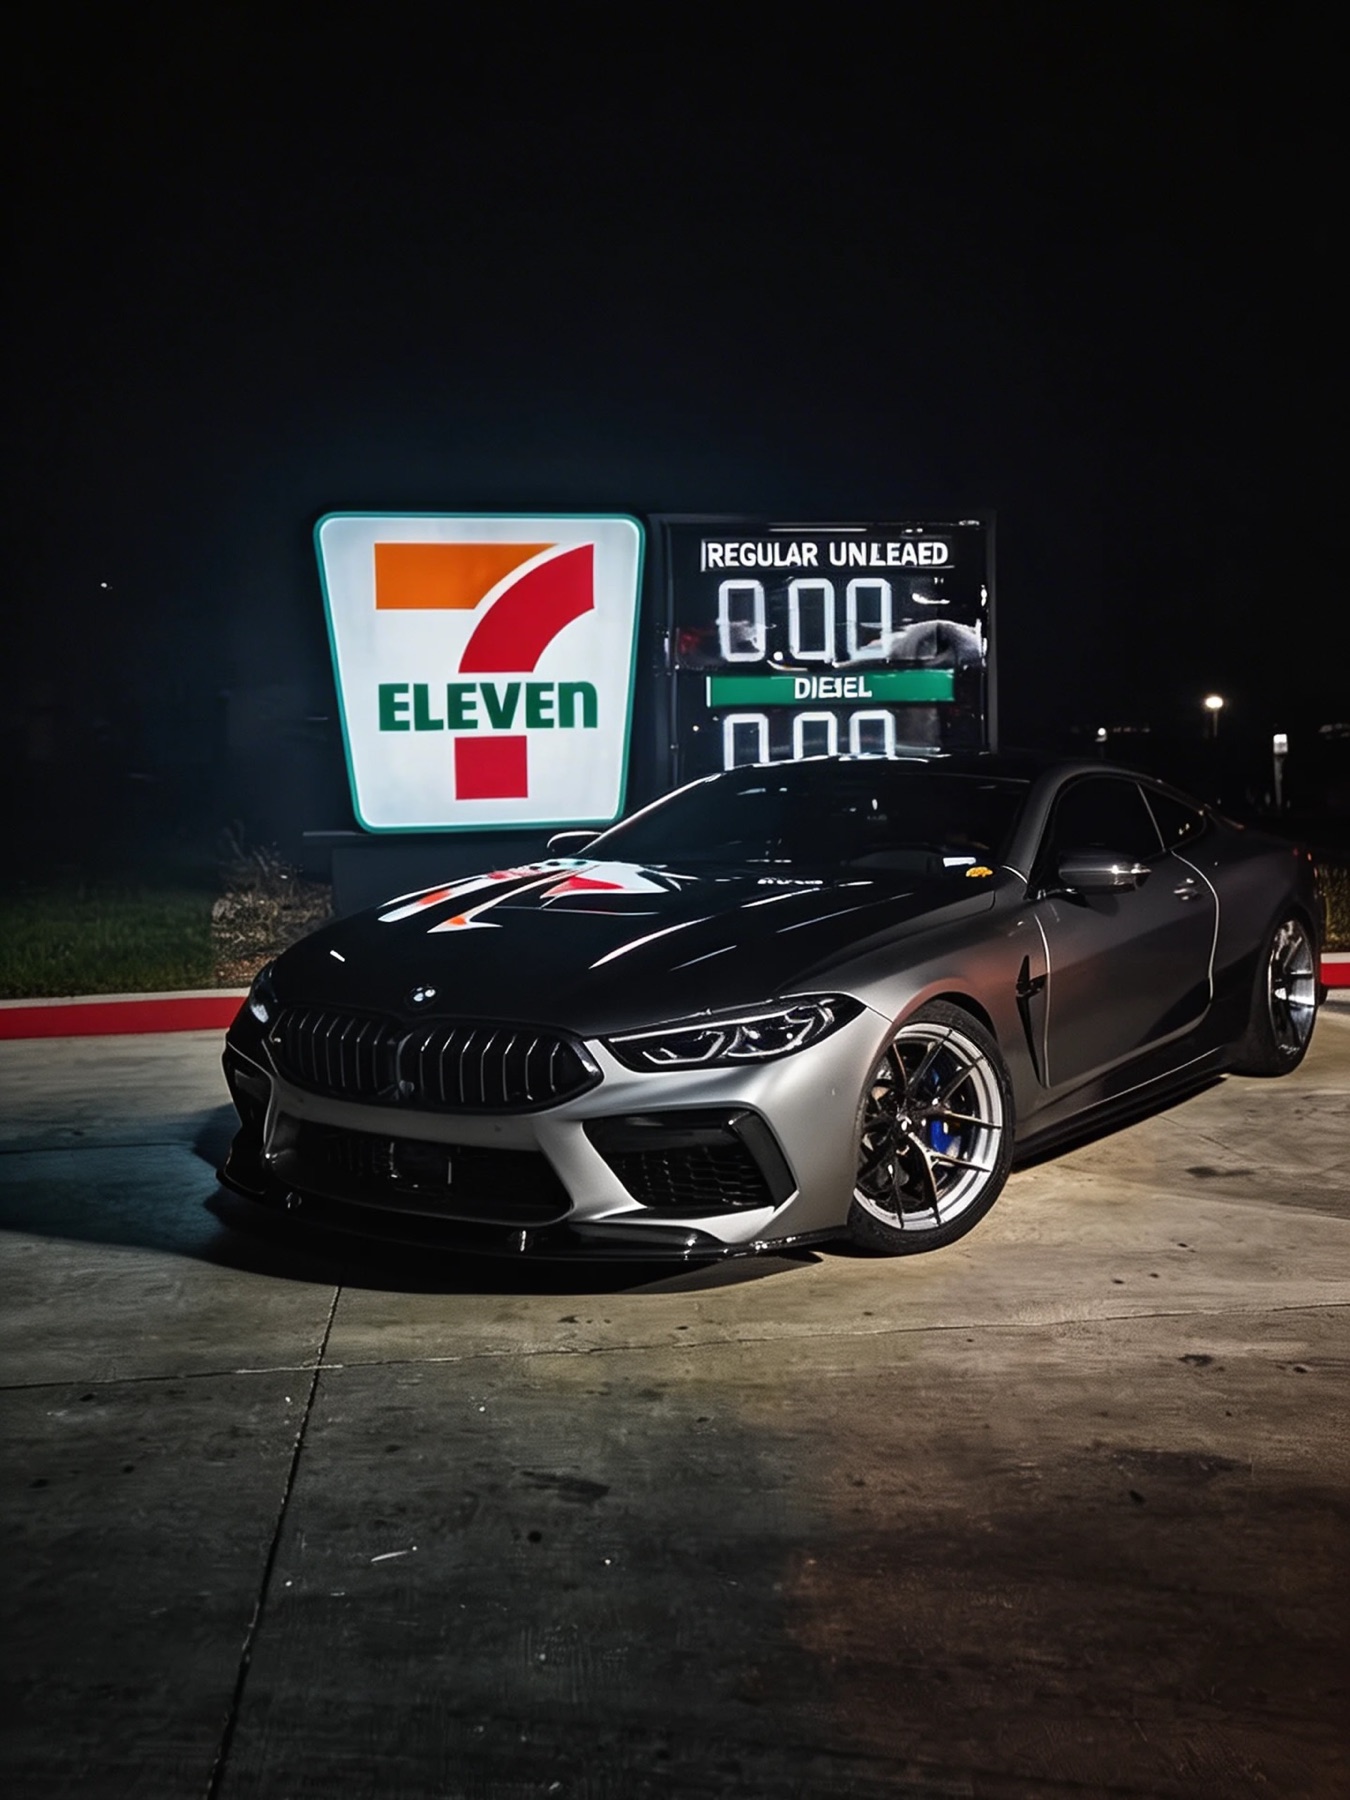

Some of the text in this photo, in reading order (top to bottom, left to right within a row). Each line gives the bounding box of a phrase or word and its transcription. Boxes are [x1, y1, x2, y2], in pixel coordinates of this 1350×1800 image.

[707, 542, 819, 567] REGULAR
[718, 578, 893, 662] 0.00
[374, 543, 594, 800] 7
